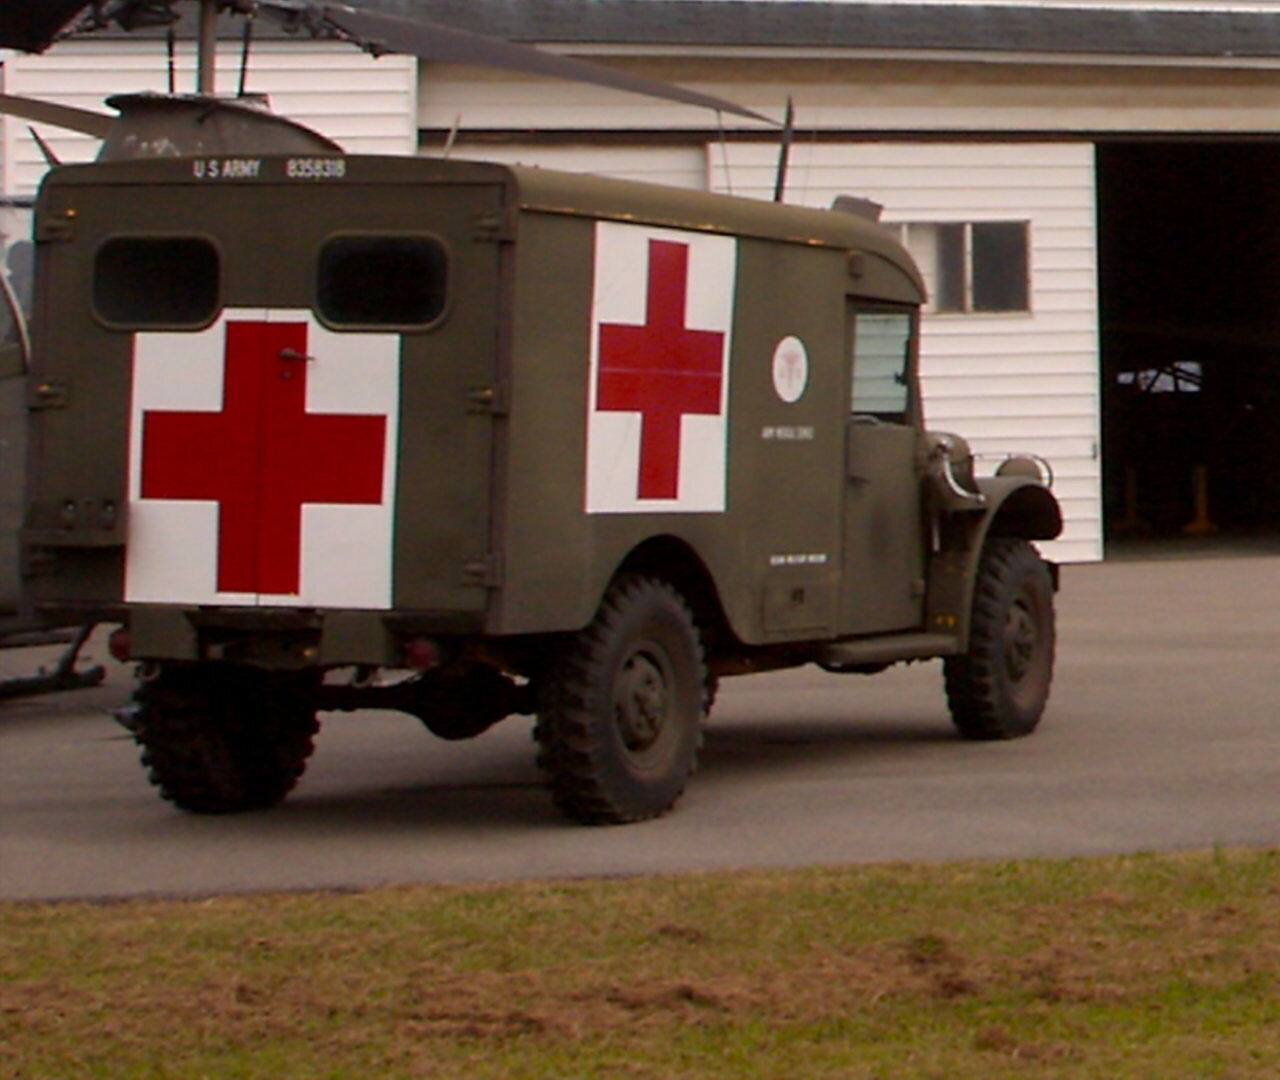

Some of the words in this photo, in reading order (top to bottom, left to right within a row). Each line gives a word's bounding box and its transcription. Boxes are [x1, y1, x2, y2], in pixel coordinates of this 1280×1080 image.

[193, 159, 205, 178] U
[208, 159, 219, 178] S
[222, 158, 261, 178] ARMY
